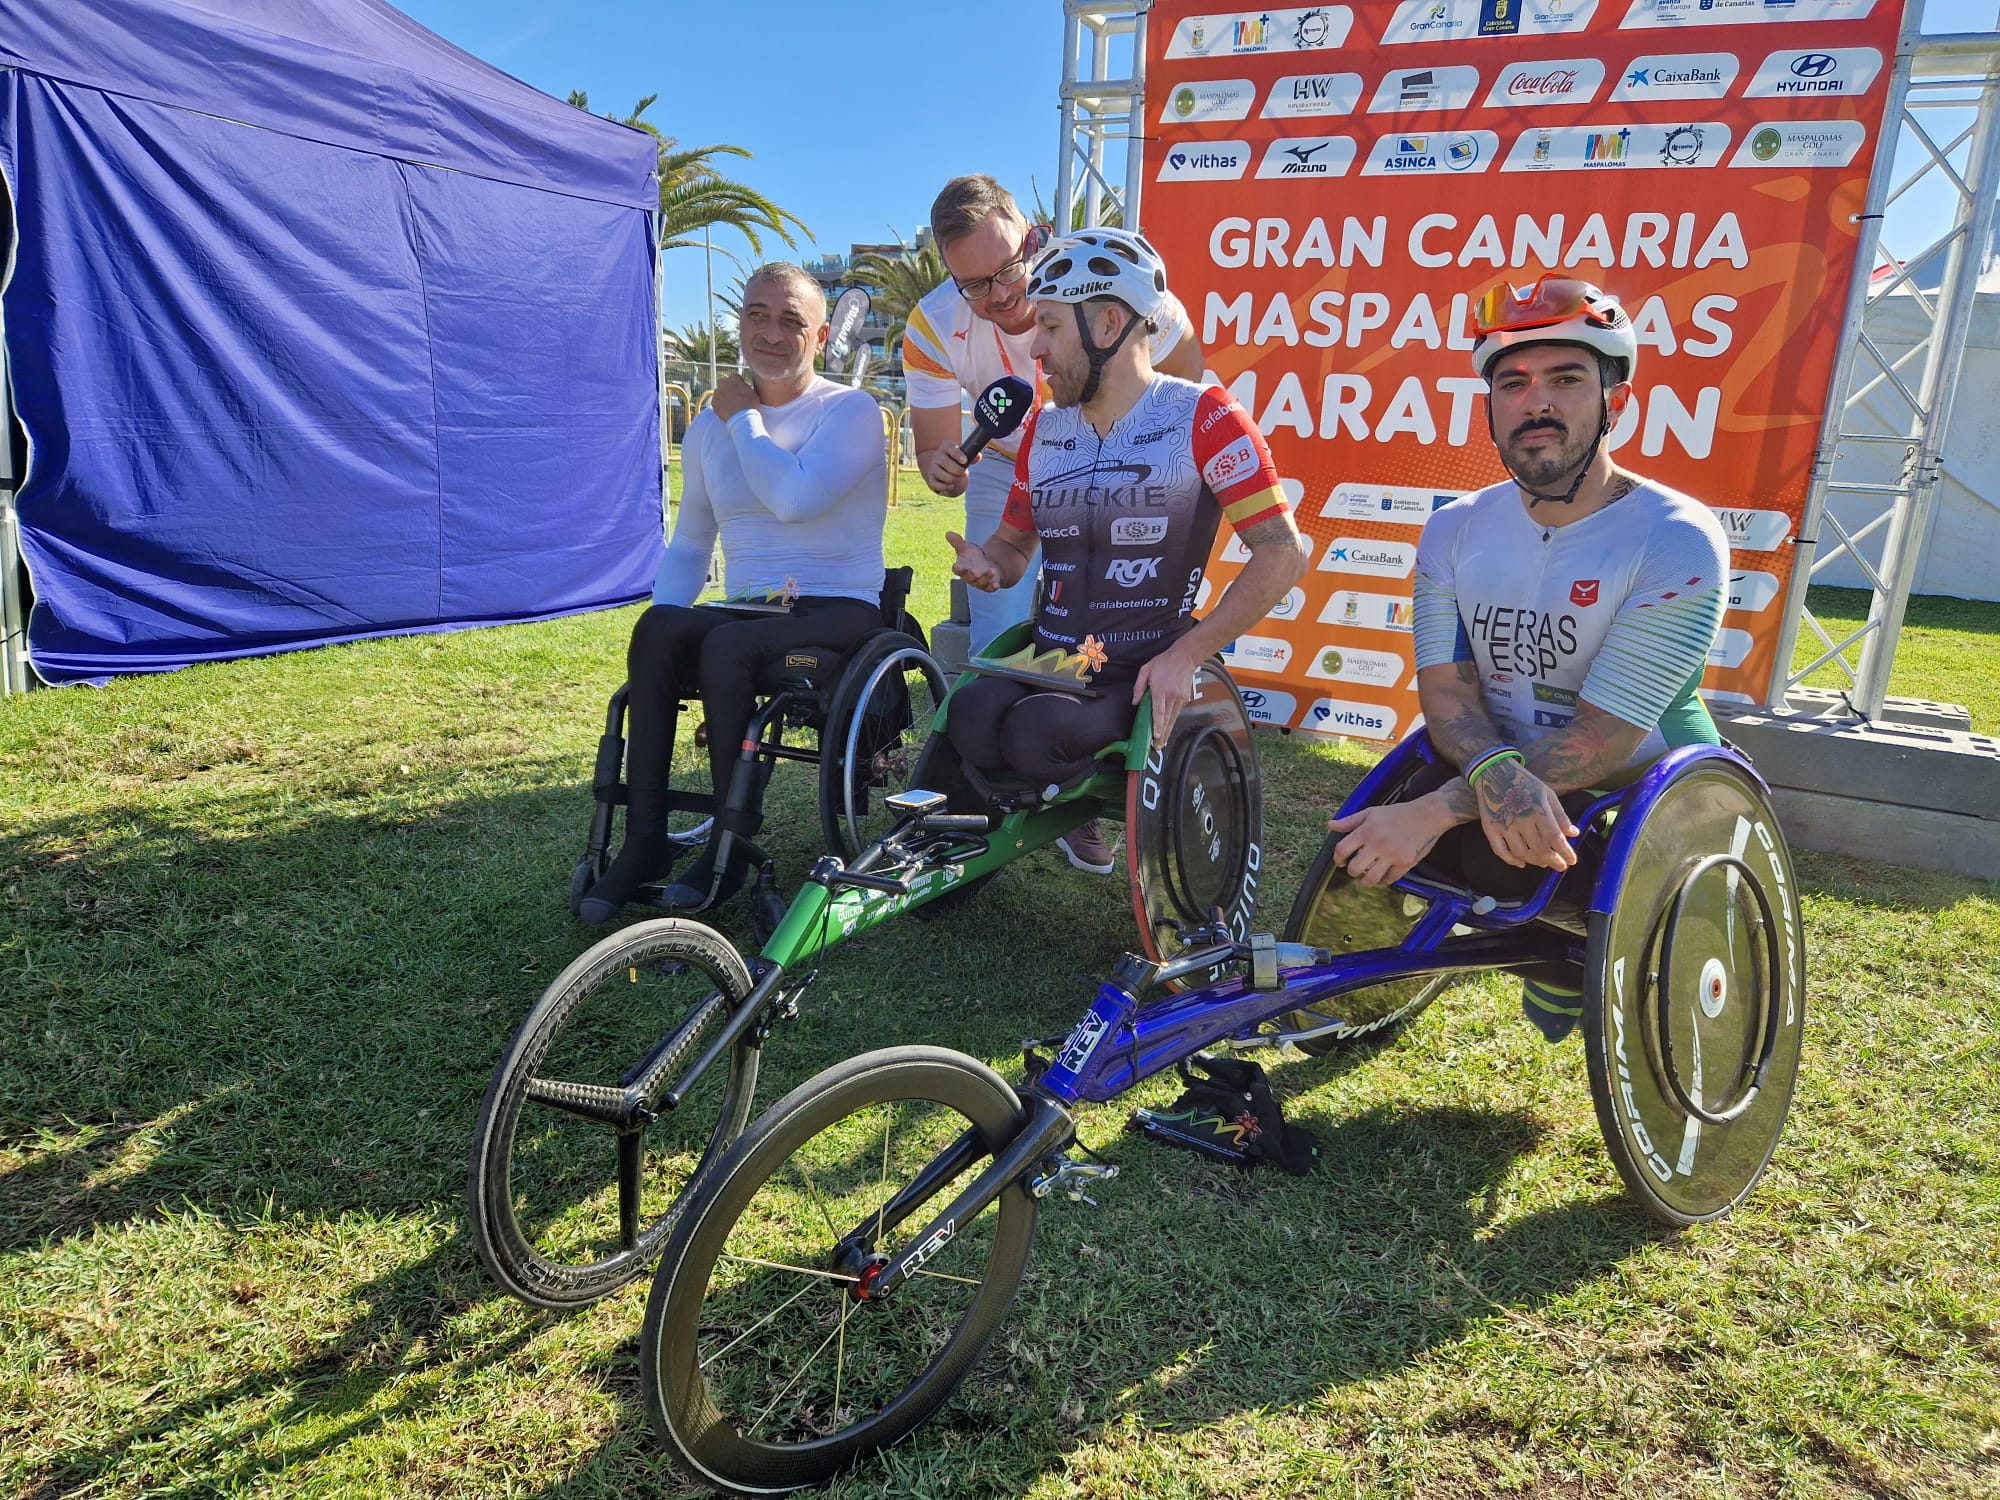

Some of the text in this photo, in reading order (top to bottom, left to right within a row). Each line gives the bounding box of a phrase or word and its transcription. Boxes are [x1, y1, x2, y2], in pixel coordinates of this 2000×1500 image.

[1508, 70, 1580, 97] Coca-Cola
[1654, 68, 1721, 84] CaixaBank
[1776, 80, 1843, 93] HYUNDAI
[1786, 133, 1843, 144] MASPALOMAS
[1803, 142, 1824, 150] GOLF
[1190, 153, 1237, 169] vithas
[1384, 156, 1436, 169] ASINCA
[1208, 211, 1750, 269] GRAN CANARIA
[1062, 281, 1113, 297] catlike
[1202, 291, 1738, 358] MASPALAS
[1031, 486, 1167, 512] QUICKIE
[1393, 499, 1420, 507] Gobierno
[1351, 550, 1404, 565] CaixaBank
[1089, 597, 1168, 610] @rafabotello79
[1471, 603, 1577, 655] HERAS
[1347, 657, 1388, 669] MASPALOMAS
[1489, 642, 1557, 680] ESP
[1334, 711, 1383, 728] vithas
[1754, 820, 1796, 1027] CORIMA
[1061, 1011, 1105, 1075] REV
[1611, 955, 1674, 1183] CORIMA
[901, 1218, 955, 1279] REV
